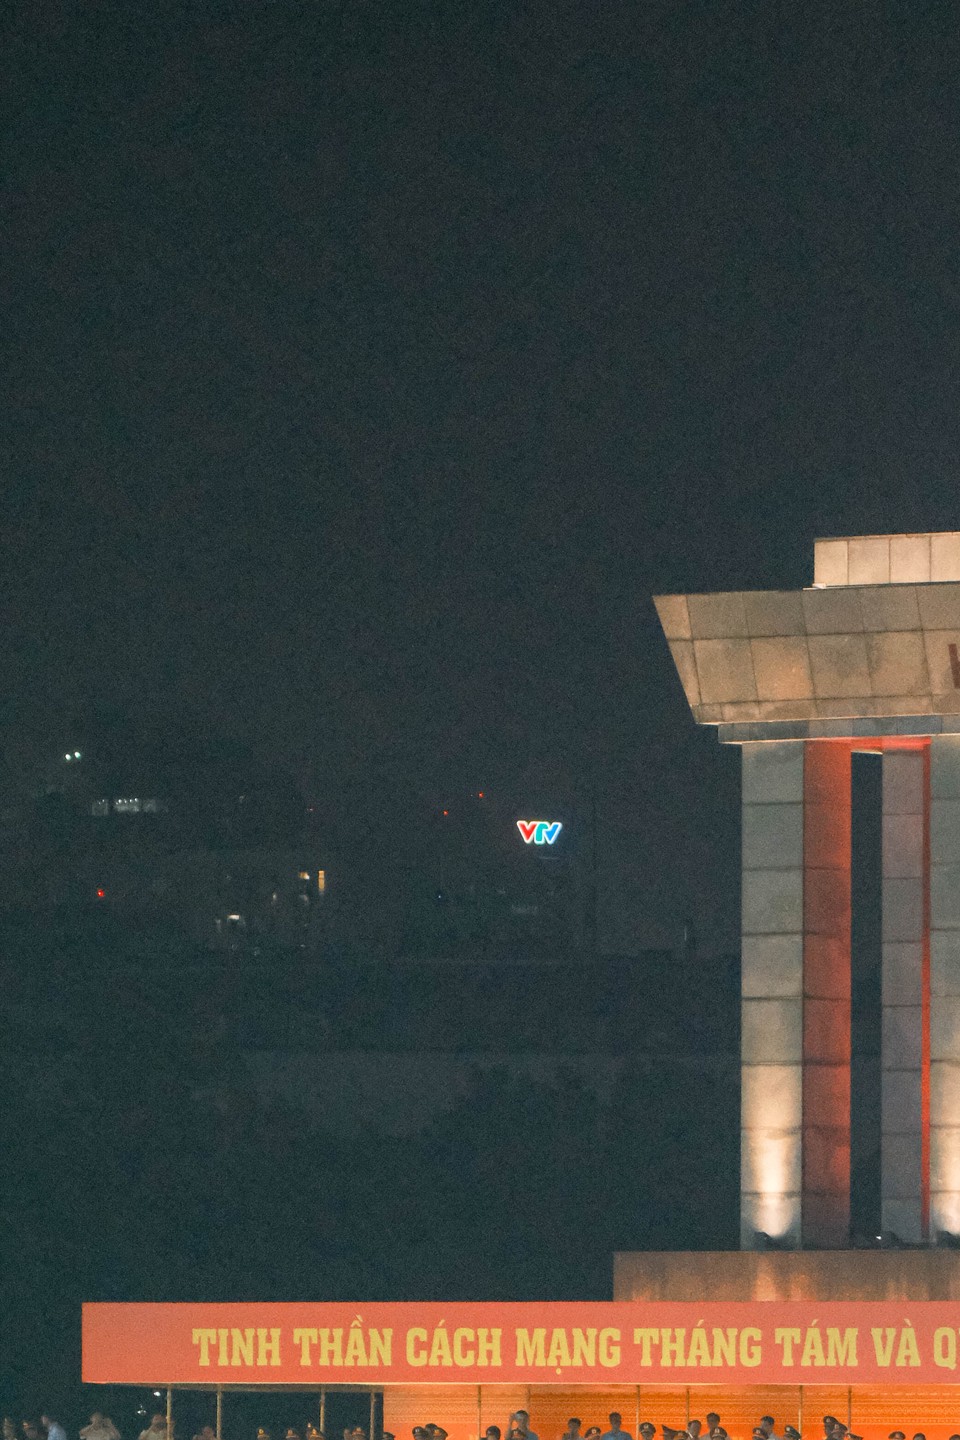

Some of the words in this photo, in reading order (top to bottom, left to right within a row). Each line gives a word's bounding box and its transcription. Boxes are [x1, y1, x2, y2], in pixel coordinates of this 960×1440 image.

[517, 820, 562, 844] VTV
[192, 1328, 281, 1366] TINH
[293, 1315, 393, 1366] THẦN
[406, 1320, 502, 1367] CÁCH
[515, 1328, 621, 1375] MẠNG
[633, 1320, 762, 1367] THÁNG
[774, 1320, 859, 1367] TÁM
[870, 1319, 922, 1367] VÀ
